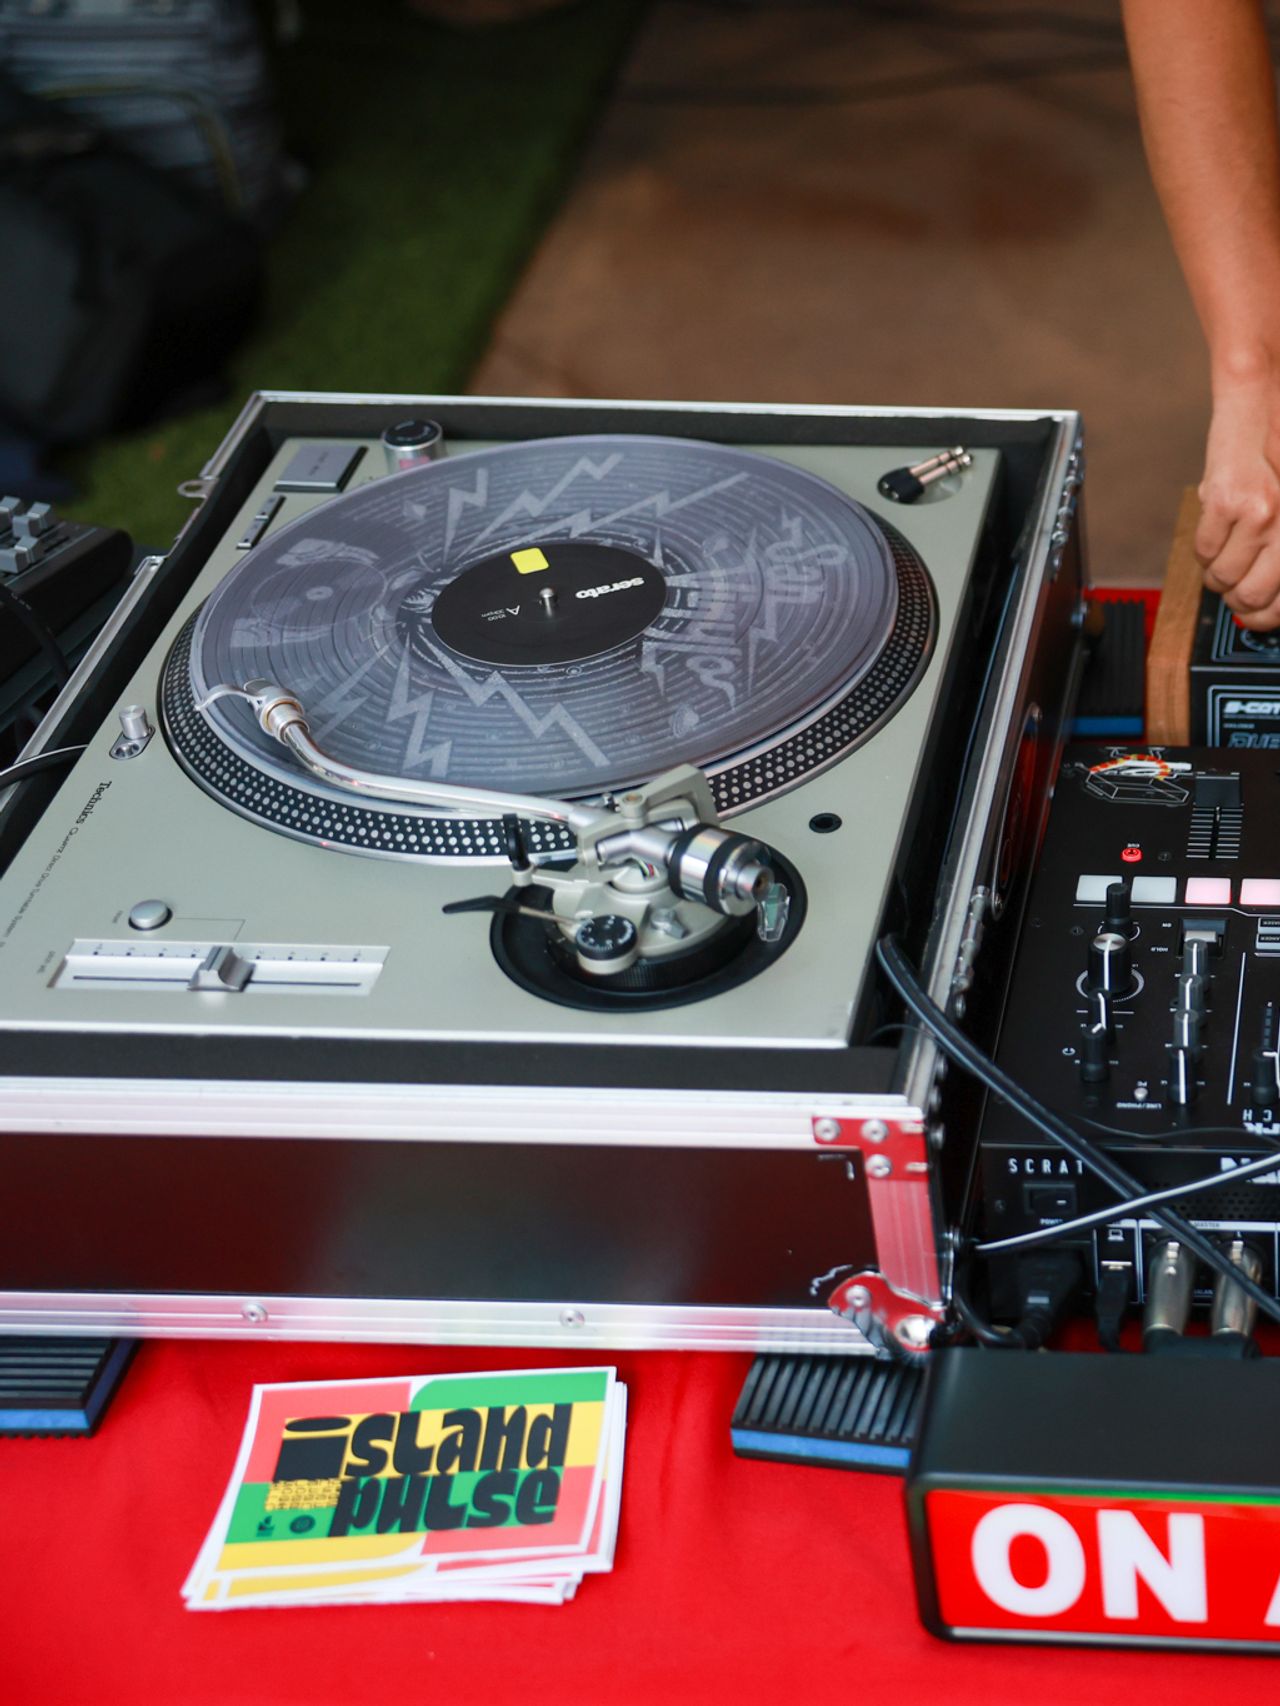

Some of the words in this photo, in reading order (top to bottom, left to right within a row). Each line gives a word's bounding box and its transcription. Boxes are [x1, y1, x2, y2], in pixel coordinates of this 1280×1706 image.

[575, 577, 645, 599] serato
[506, 605, 520, 615] A
[76, 781, 112, 824] Technics
[1008, 1157, 1084, 1175] SCRAT
[971, 1503, 1208, 1623] ON
